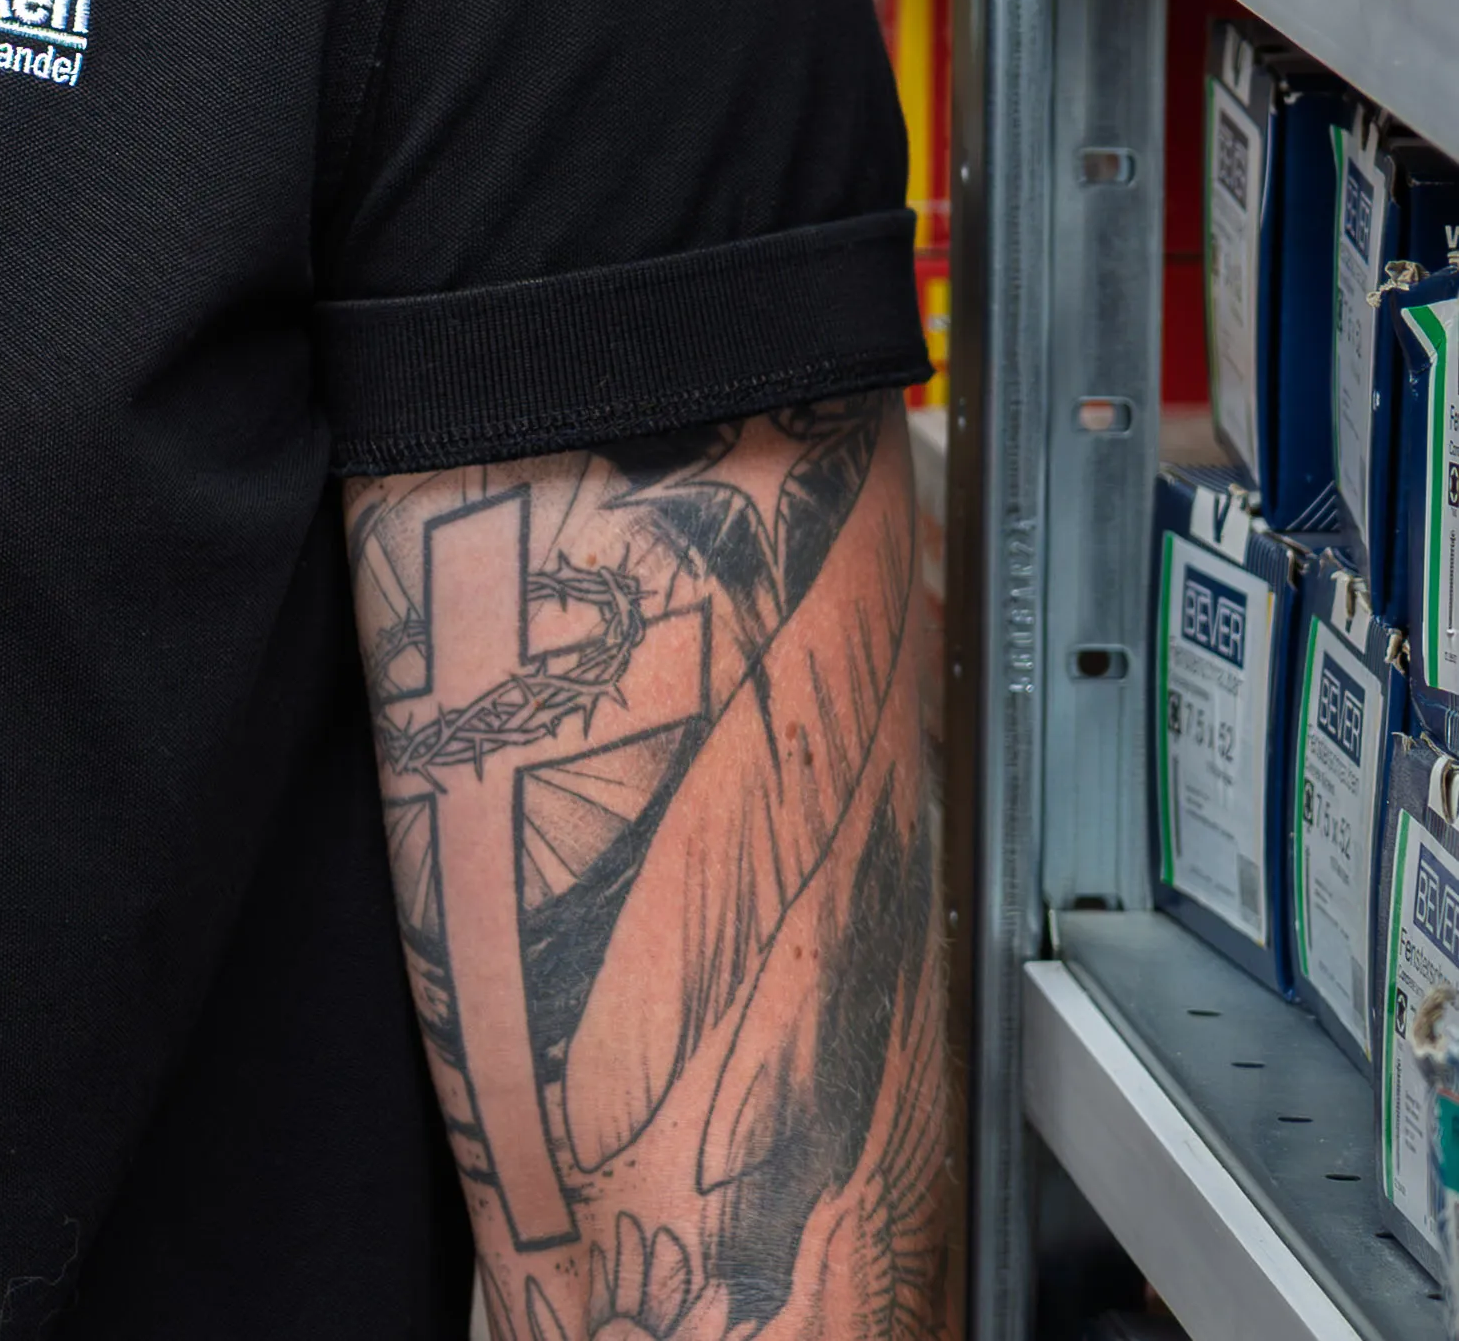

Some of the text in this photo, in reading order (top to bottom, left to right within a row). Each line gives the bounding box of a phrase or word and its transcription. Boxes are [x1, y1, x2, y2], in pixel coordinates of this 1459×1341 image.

[1183, 580, 1245, 662] BEVER
[1319, 668, 1363, 758] BEVER
[1416, 859, 1459, 965] BEVER
